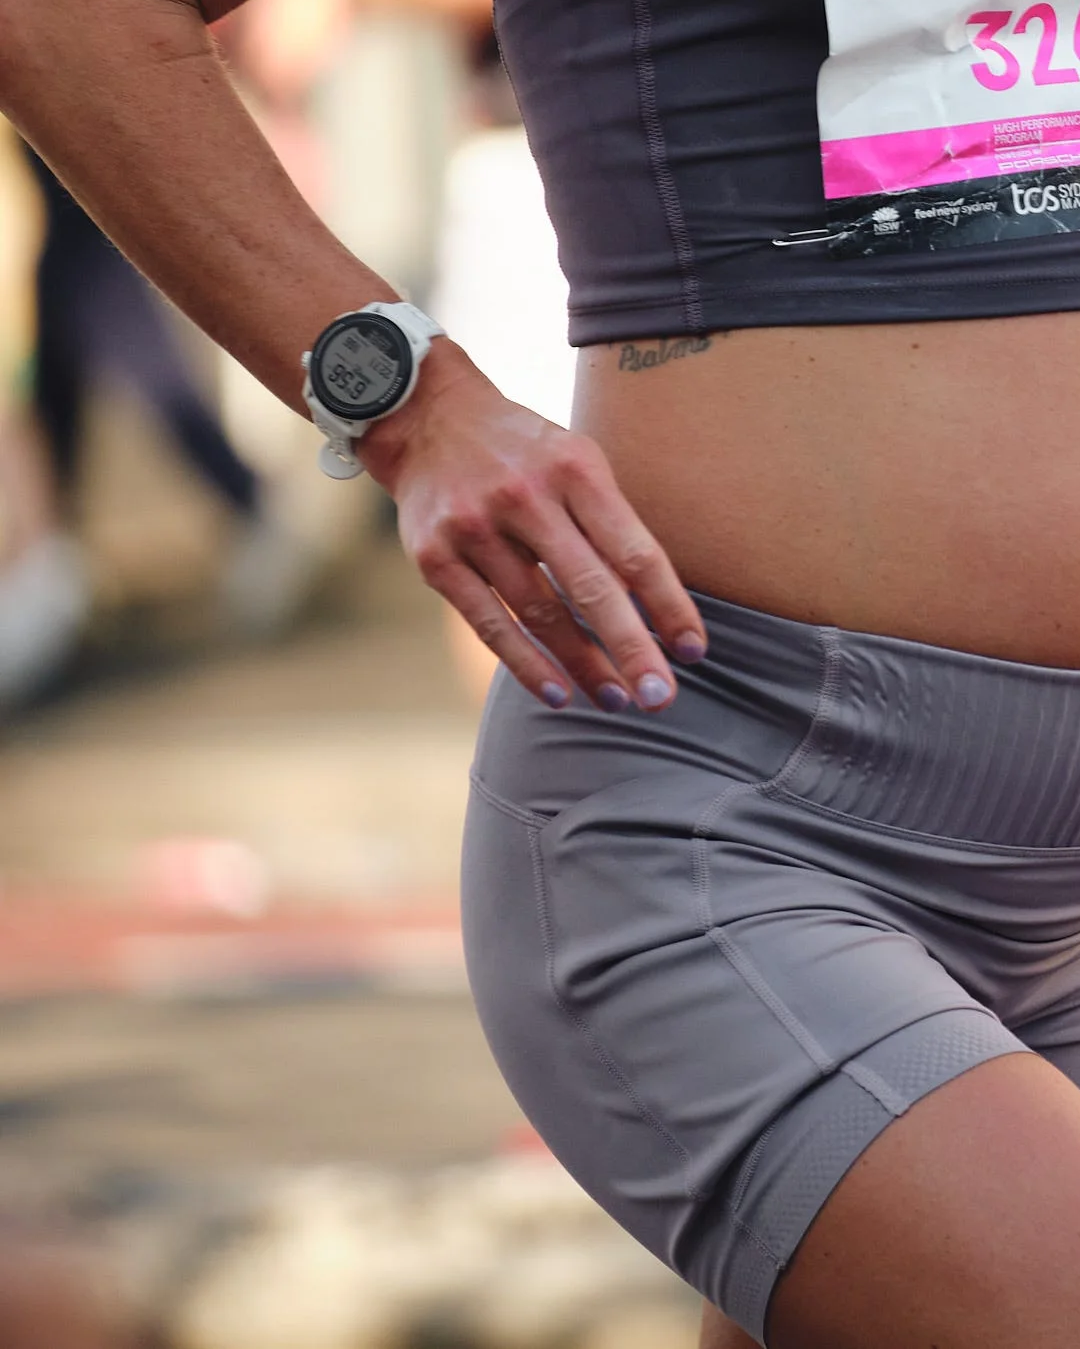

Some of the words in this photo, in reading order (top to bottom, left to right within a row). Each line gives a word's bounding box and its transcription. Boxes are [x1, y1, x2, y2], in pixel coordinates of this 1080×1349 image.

[993, 122, 1019, 134] HIGH
[994, 130, 1042, 145] PROGRAM
[1011, 183, 1060, 215] tcs
[914, 207, 936, 220] feel
[961, 201, 998, 215] sydney
[873, 221, 900, 232] NSW
